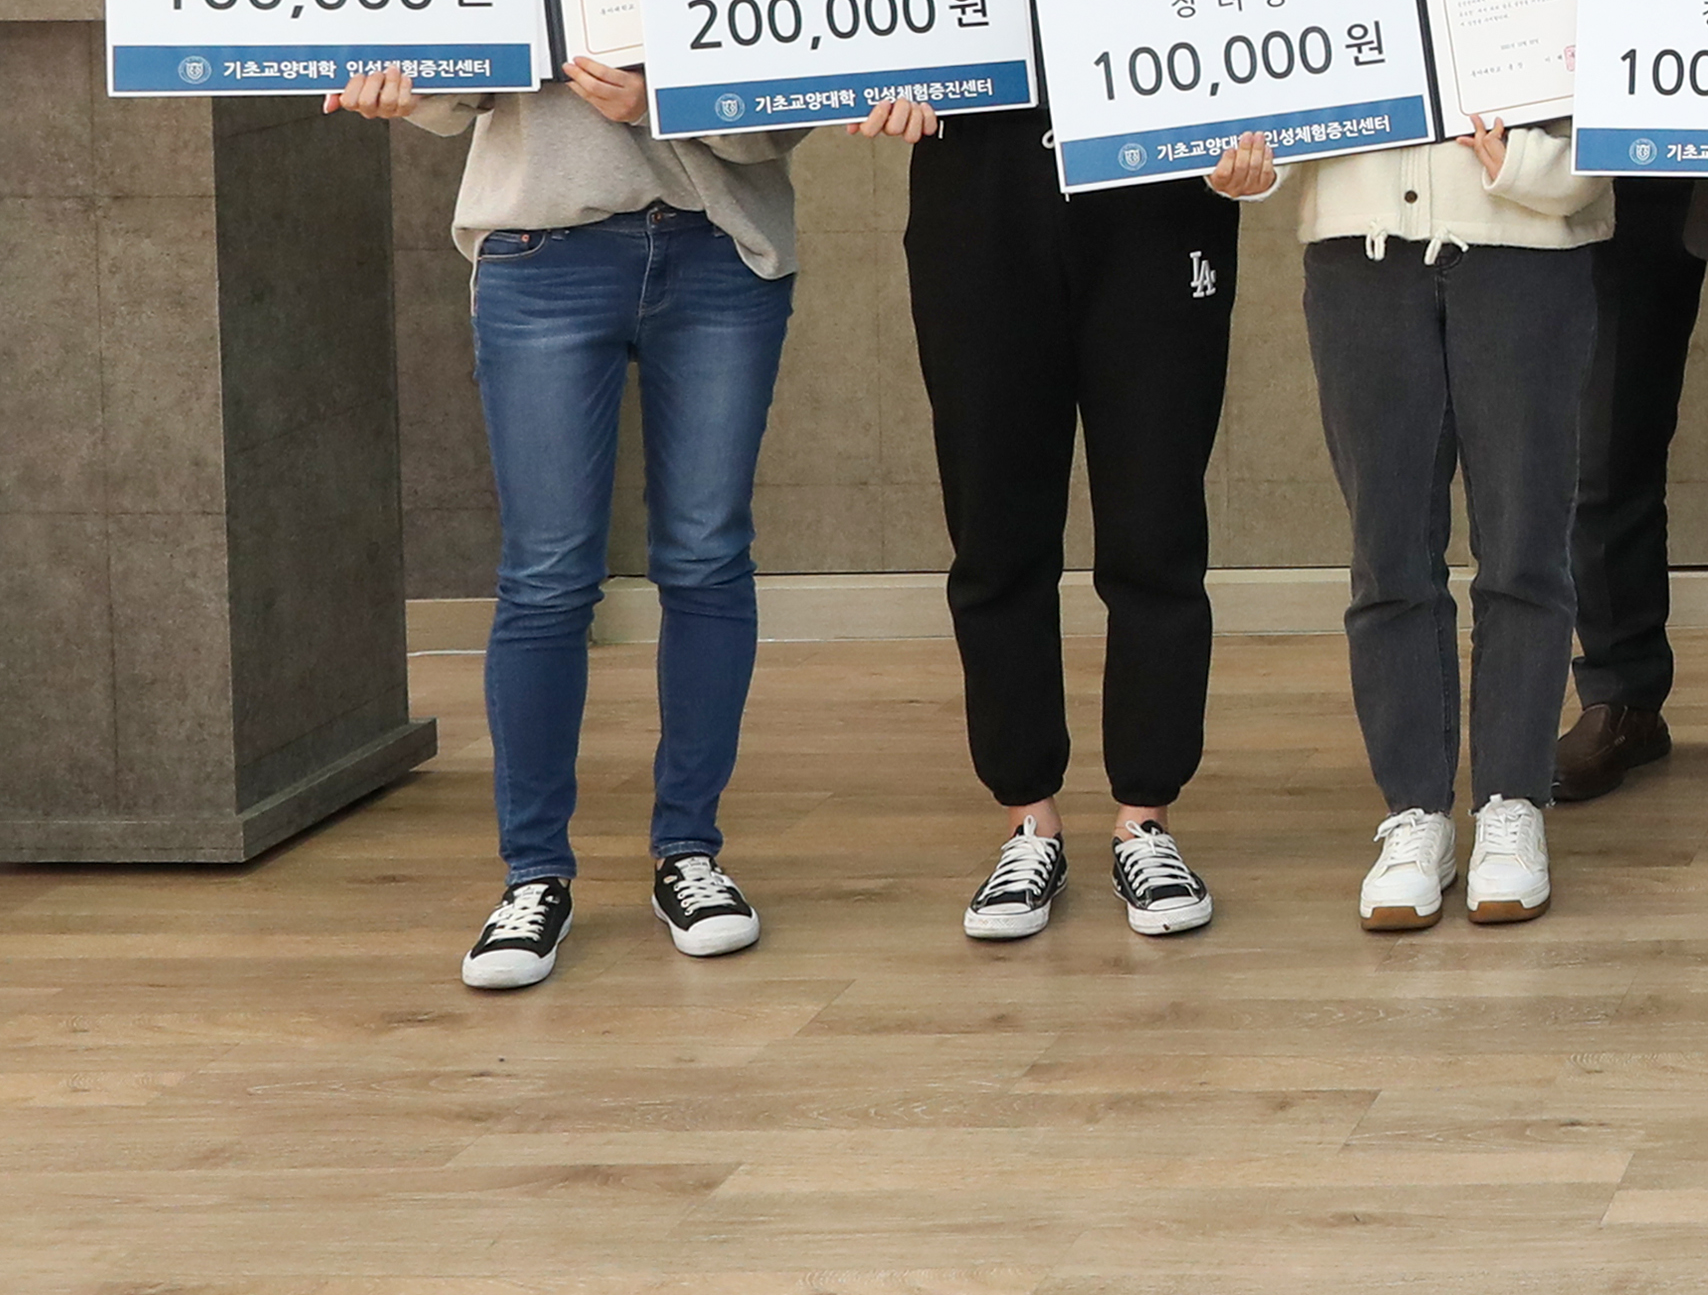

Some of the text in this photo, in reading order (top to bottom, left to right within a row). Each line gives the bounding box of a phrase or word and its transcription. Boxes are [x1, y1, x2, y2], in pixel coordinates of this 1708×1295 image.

[223, 60, 337, 80] 기초교양대학
[1094, 20, 1386, 101] 100,000 원
[755, 89, 856, 114] 기초교양대학
[1265, 115, 1390, 155] 인성체험증진센터
[1189, 251, 1216, 298] LA
